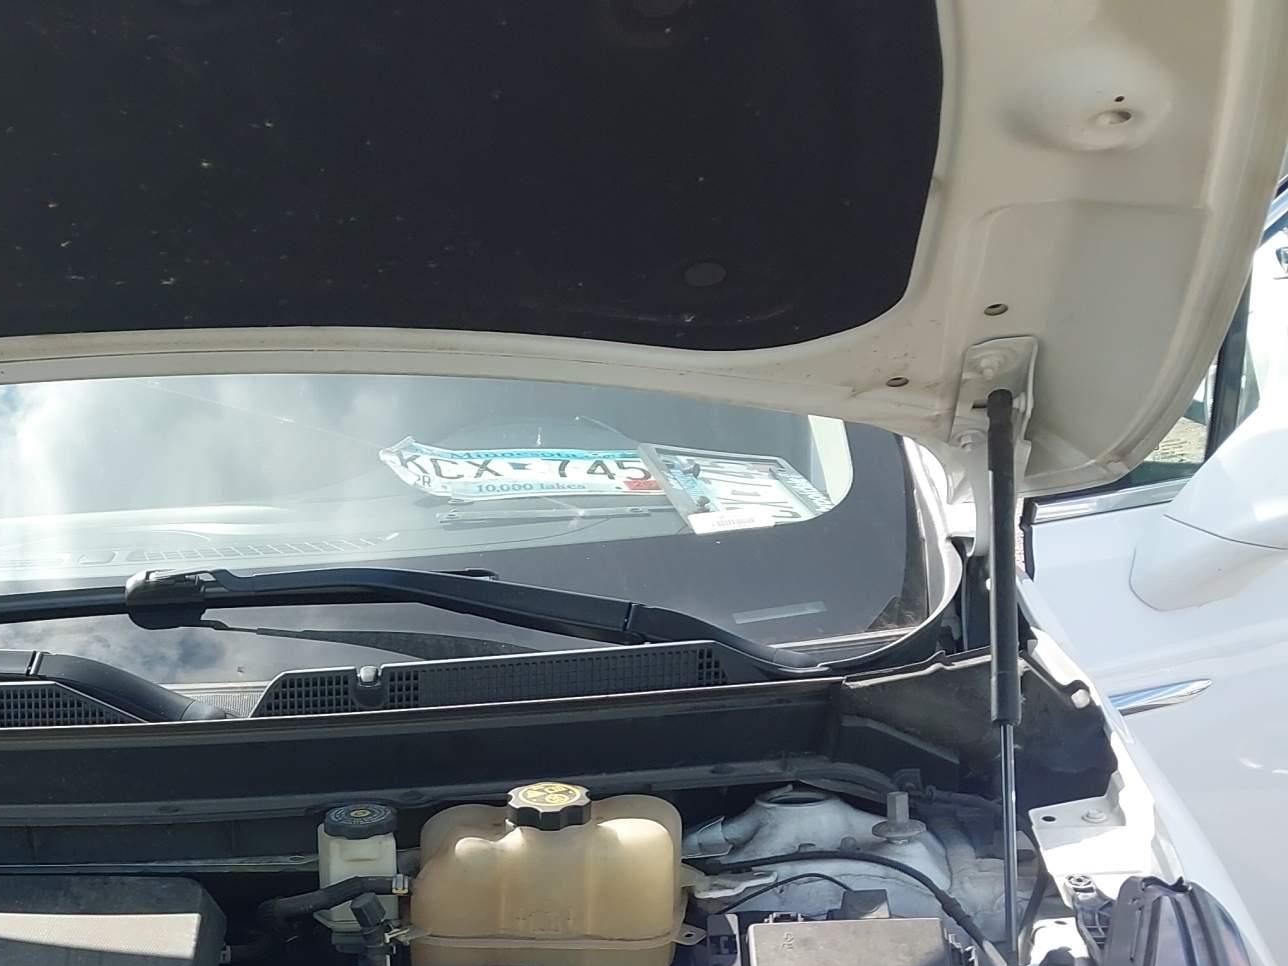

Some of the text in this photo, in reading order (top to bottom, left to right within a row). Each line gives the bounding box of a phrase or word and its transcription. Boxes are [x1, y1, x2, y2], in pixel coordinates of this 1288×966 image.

[392, 450, 504, 480] KCX
[541, 458, 652, 481] 745
[477, 482, 587, 493] 10,000 lakes
